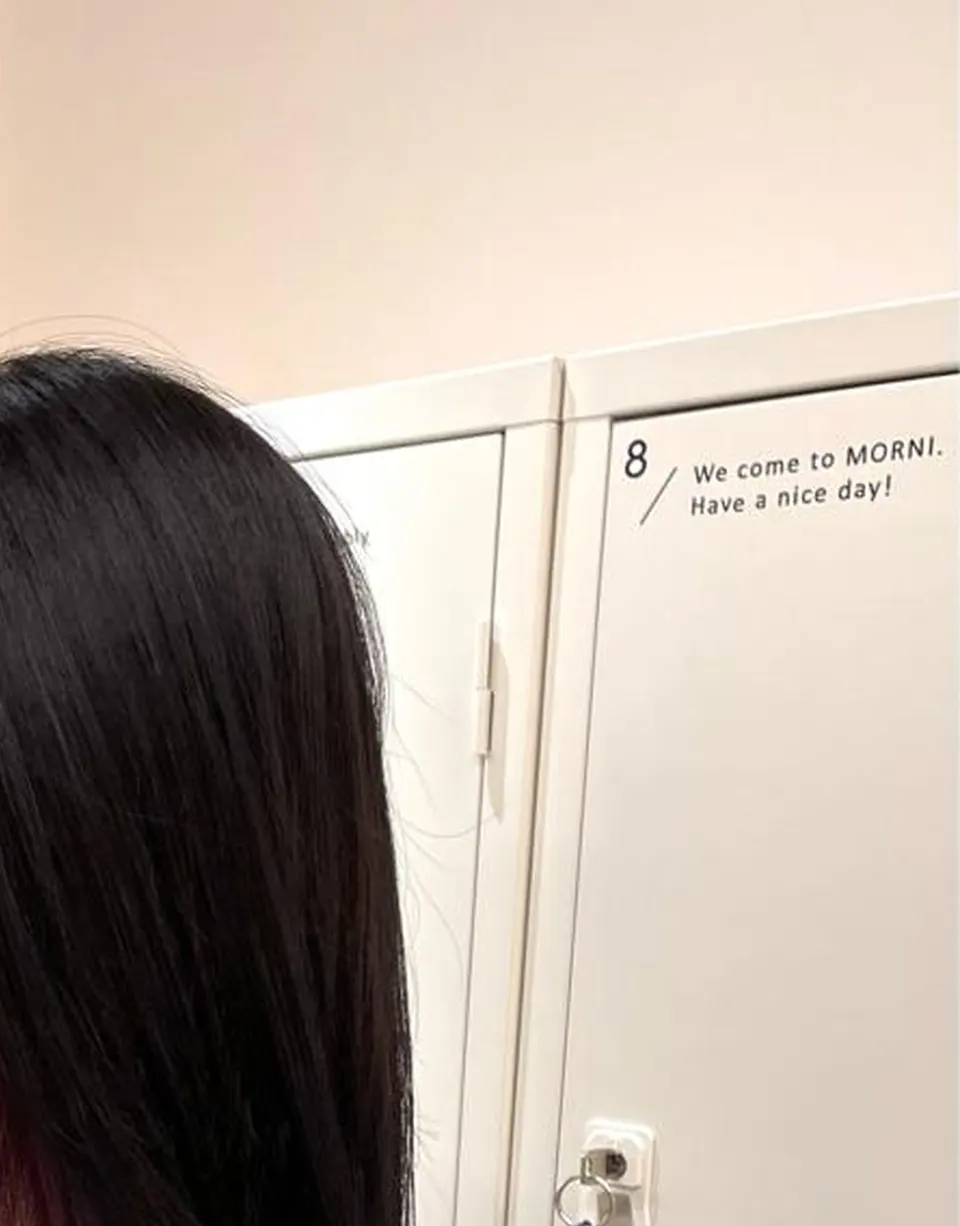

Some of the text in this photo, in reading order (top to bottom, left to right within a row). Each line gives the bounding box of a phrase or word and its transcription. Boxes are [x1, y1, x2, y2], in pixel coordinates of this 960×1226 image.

[624, 438, 649, 480] 8
[810, 451, 836, 472] to
[845, 435, 944, 467] MORNI.
[690, 473, 892, 517] Have a nice day!
